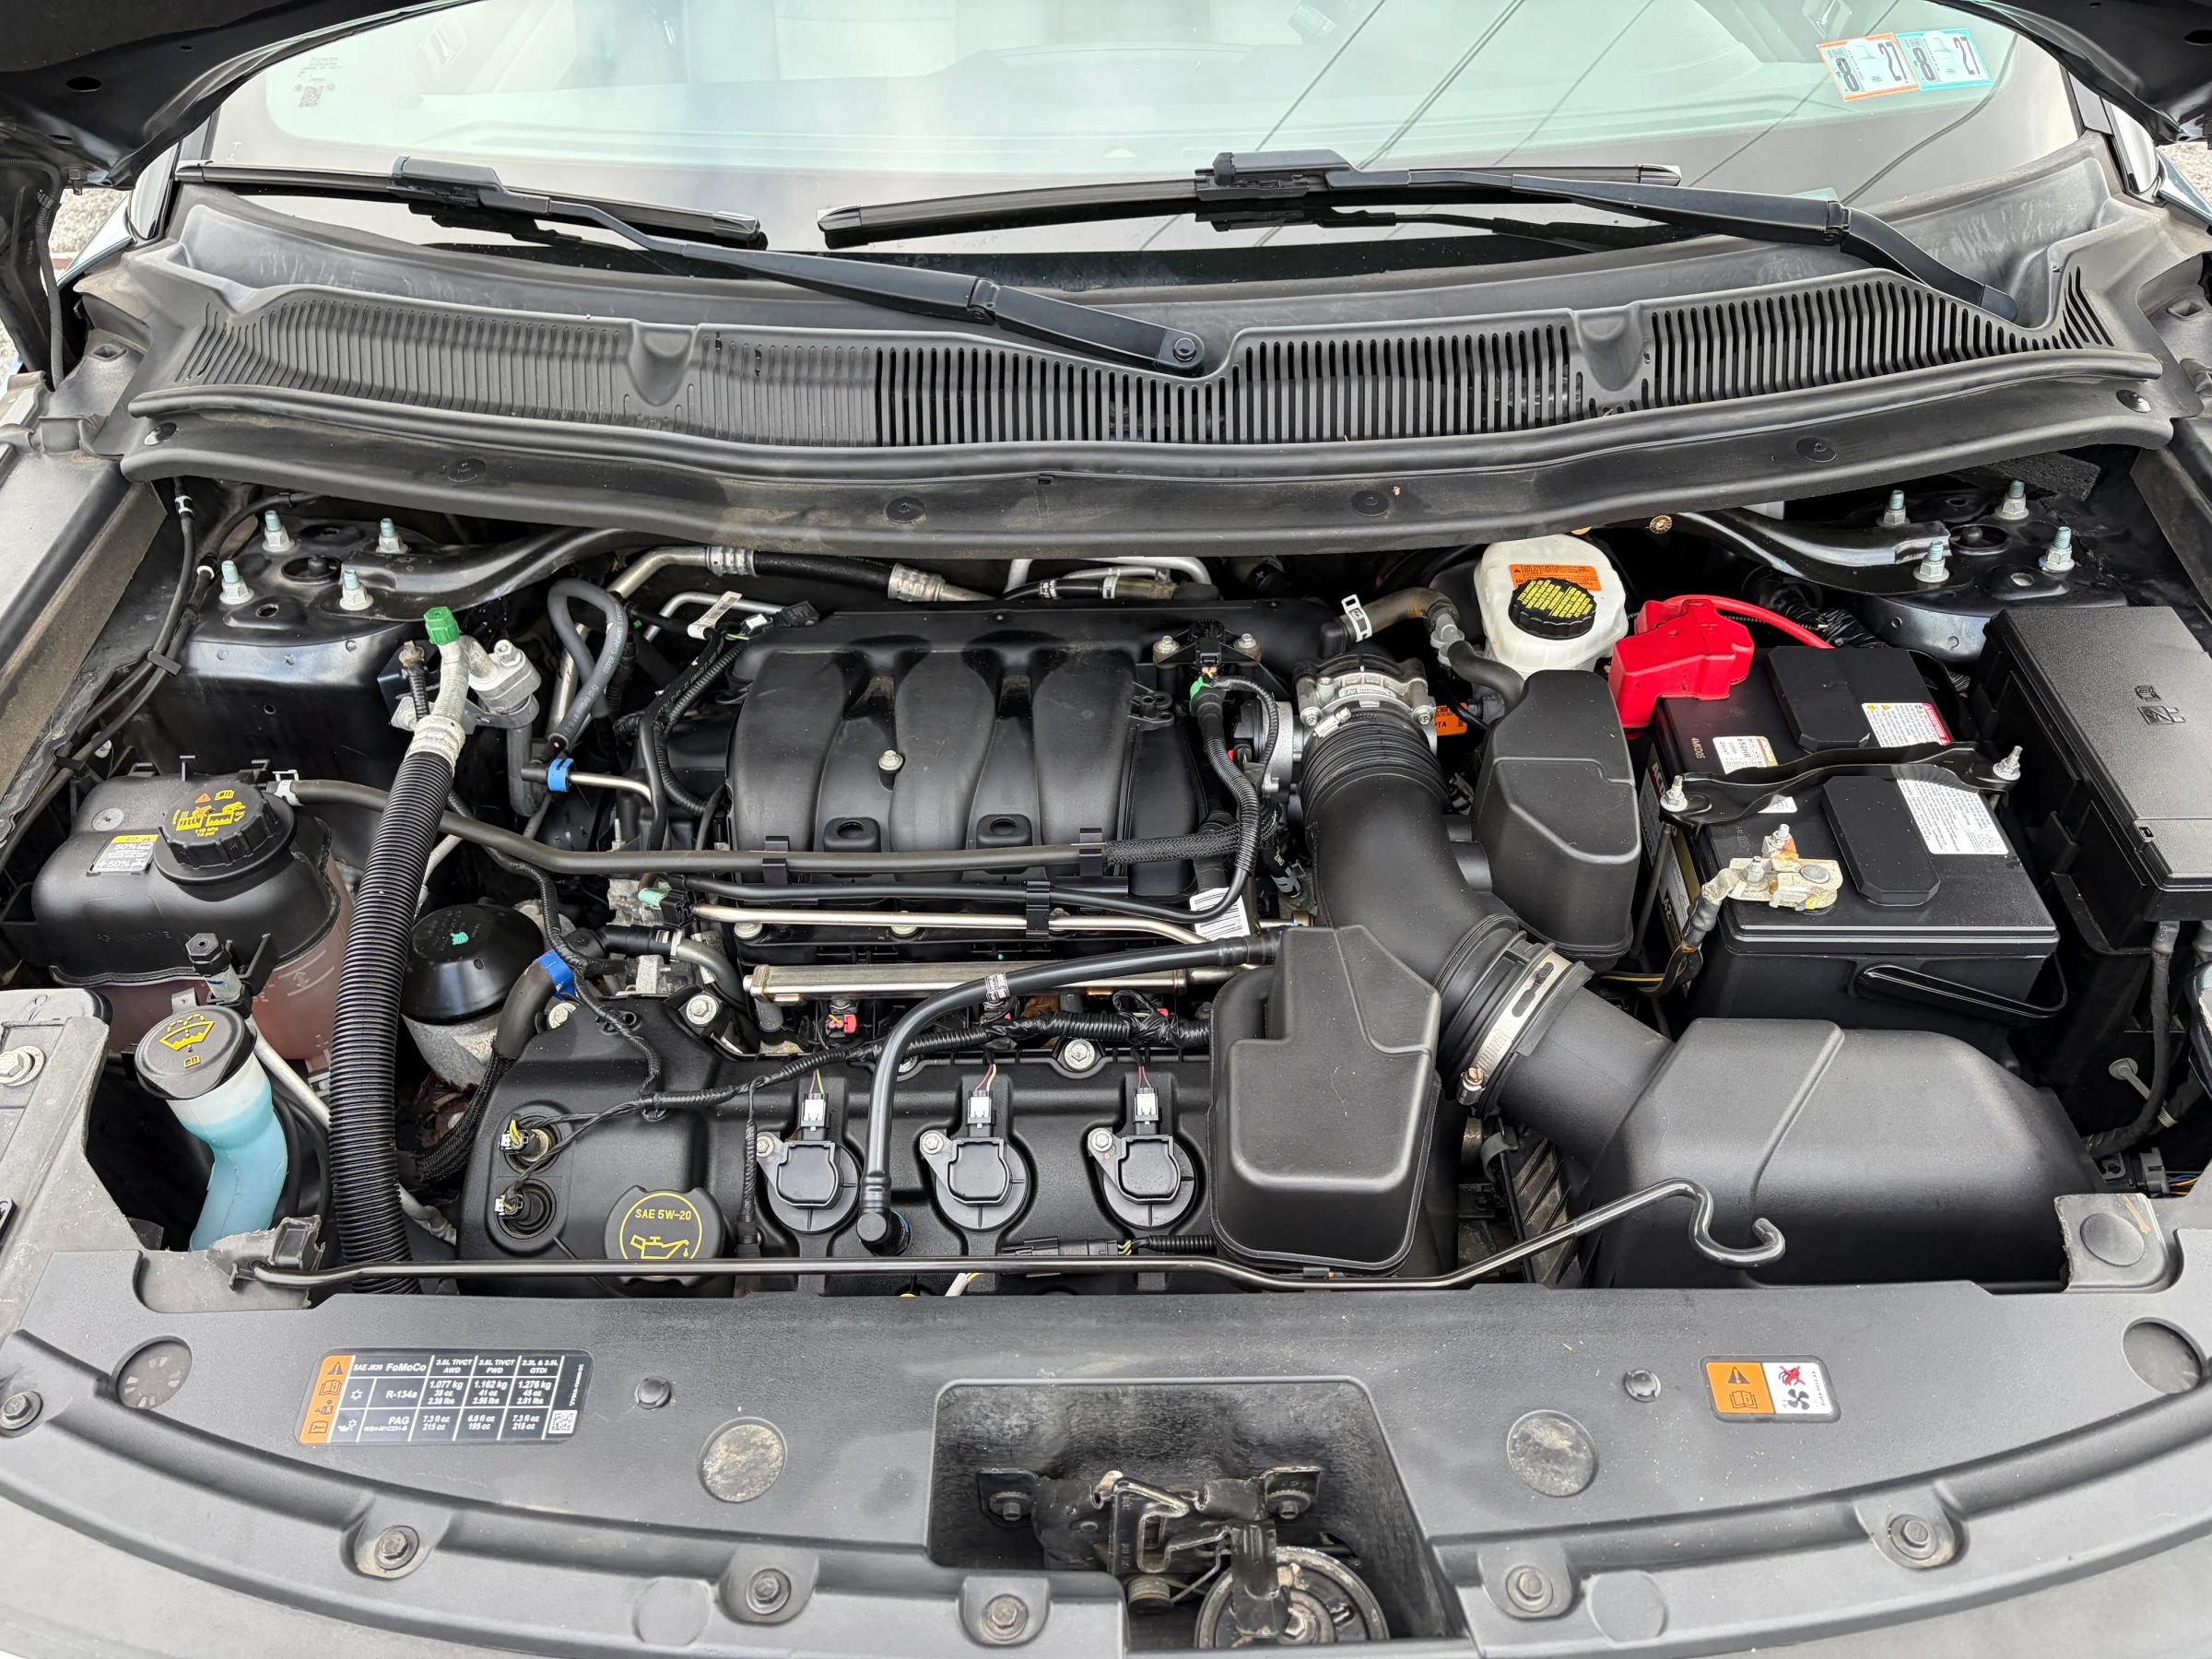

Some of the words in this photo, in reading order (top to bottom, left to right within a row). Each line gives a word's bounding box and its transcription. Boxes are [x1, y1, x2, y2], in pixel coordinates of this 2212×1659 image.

[1952, 36, 1981, 75] 27
[1877, 41, 1907, 81] 27
[1912, 47, 1936, 81] 8
[1836, 57, 1860, 92] 8
[635, 1208, 655, 1218] SAE
[657, 1209, 692, 1221] 5W-20
[385, 1362, 427, 1371] FoMoCo
[429, 1380, 452, 1389] 1.077
[452, 1380, 464, 1390] kg
[474, 1380, 496, 1389] 1.162
[496, 1380, 508, 1390] kg
[518, 1380, 540, 1389] 1.276
[541, 1380, 552, 1390] kg
[385, 1390, 418, 1399] R-134a
[388, 1417, 410, 1425] PAG
